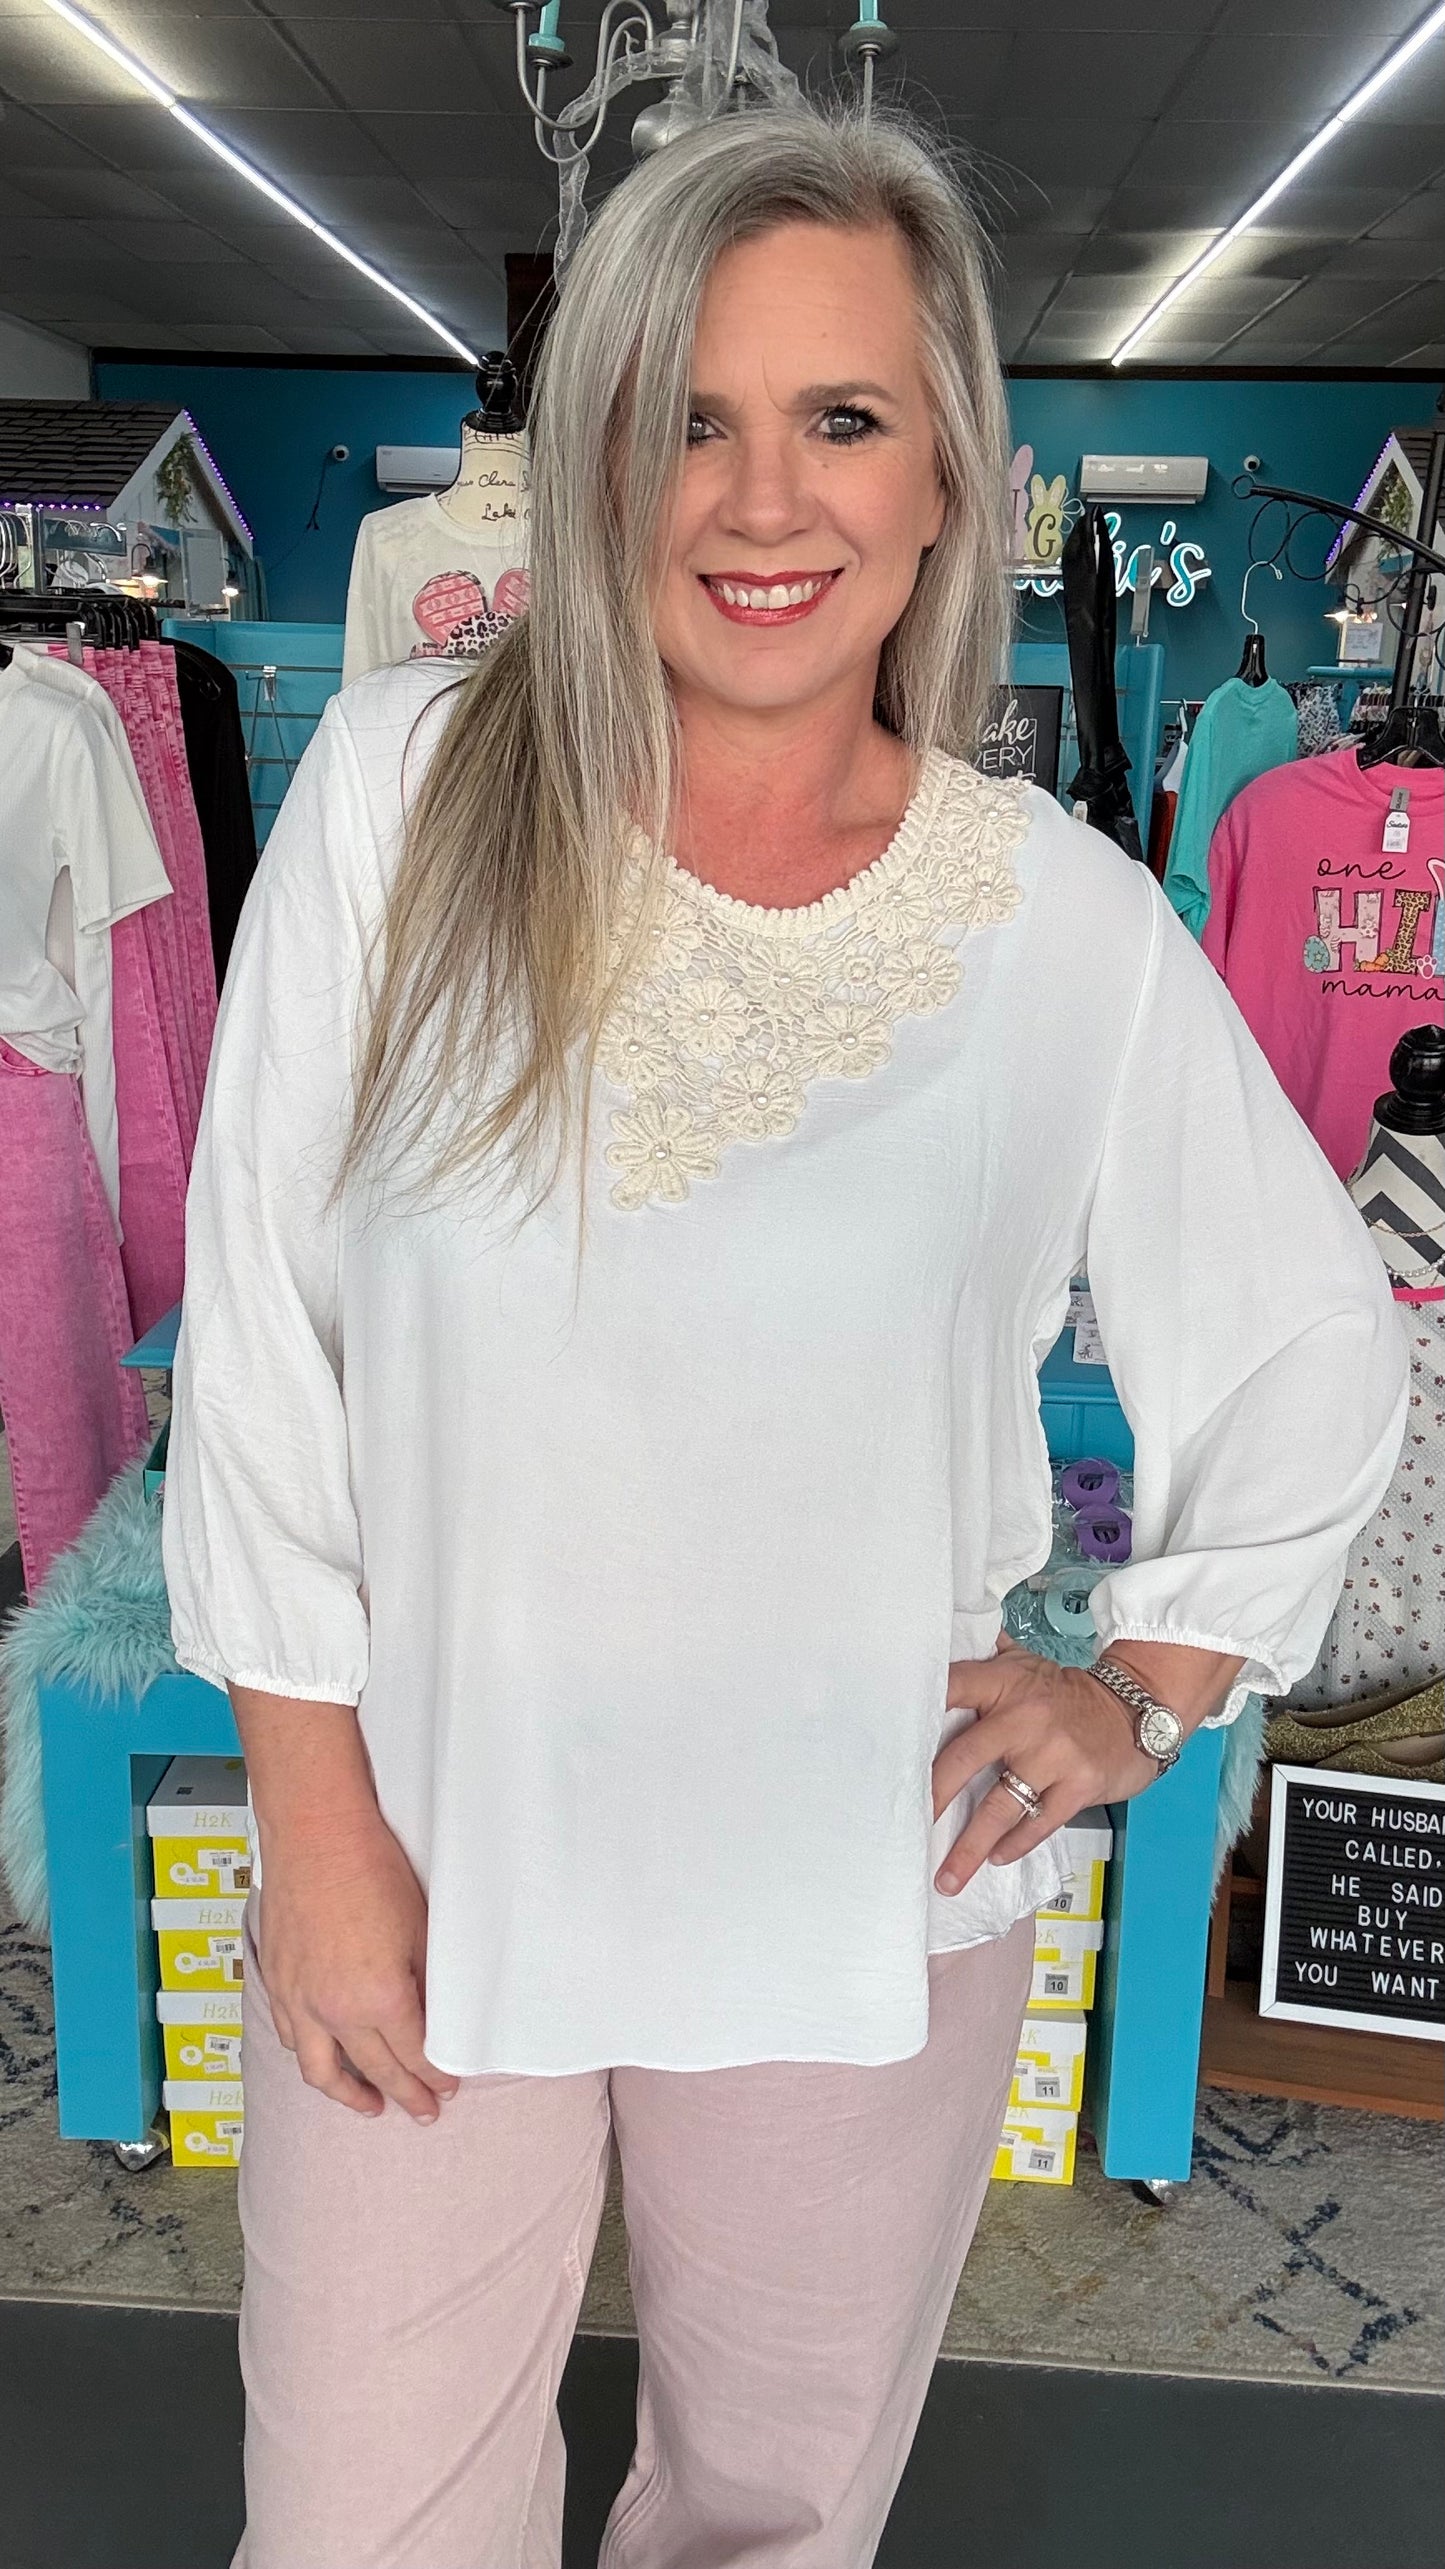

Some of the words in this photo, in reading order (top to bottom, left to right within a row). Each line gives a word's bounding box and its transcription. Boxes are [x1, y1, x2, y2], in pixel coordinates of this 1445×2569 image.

[1317, 858, 1406, 879] one
[1322, 979, 1445, 1001] mama
[194, 1811, 233, 1828] H2K
[1302, 1797, 1357, 1825] YOUR
[1331, 1874, 1361, 1898] HE
[1391, 1882, 1443, 1908] SAID
[198, 1908, 236, 1925] H2K
[1357, 1905, 1408, 1931] BUY
[1310, 1926, 1444, 1964] WHATEVER
[1051, 1981, 1064, 1991] 10
[1295, 1961, 1338, 1986] YOU
[1371, 1971, 1440, 2000] WANT
